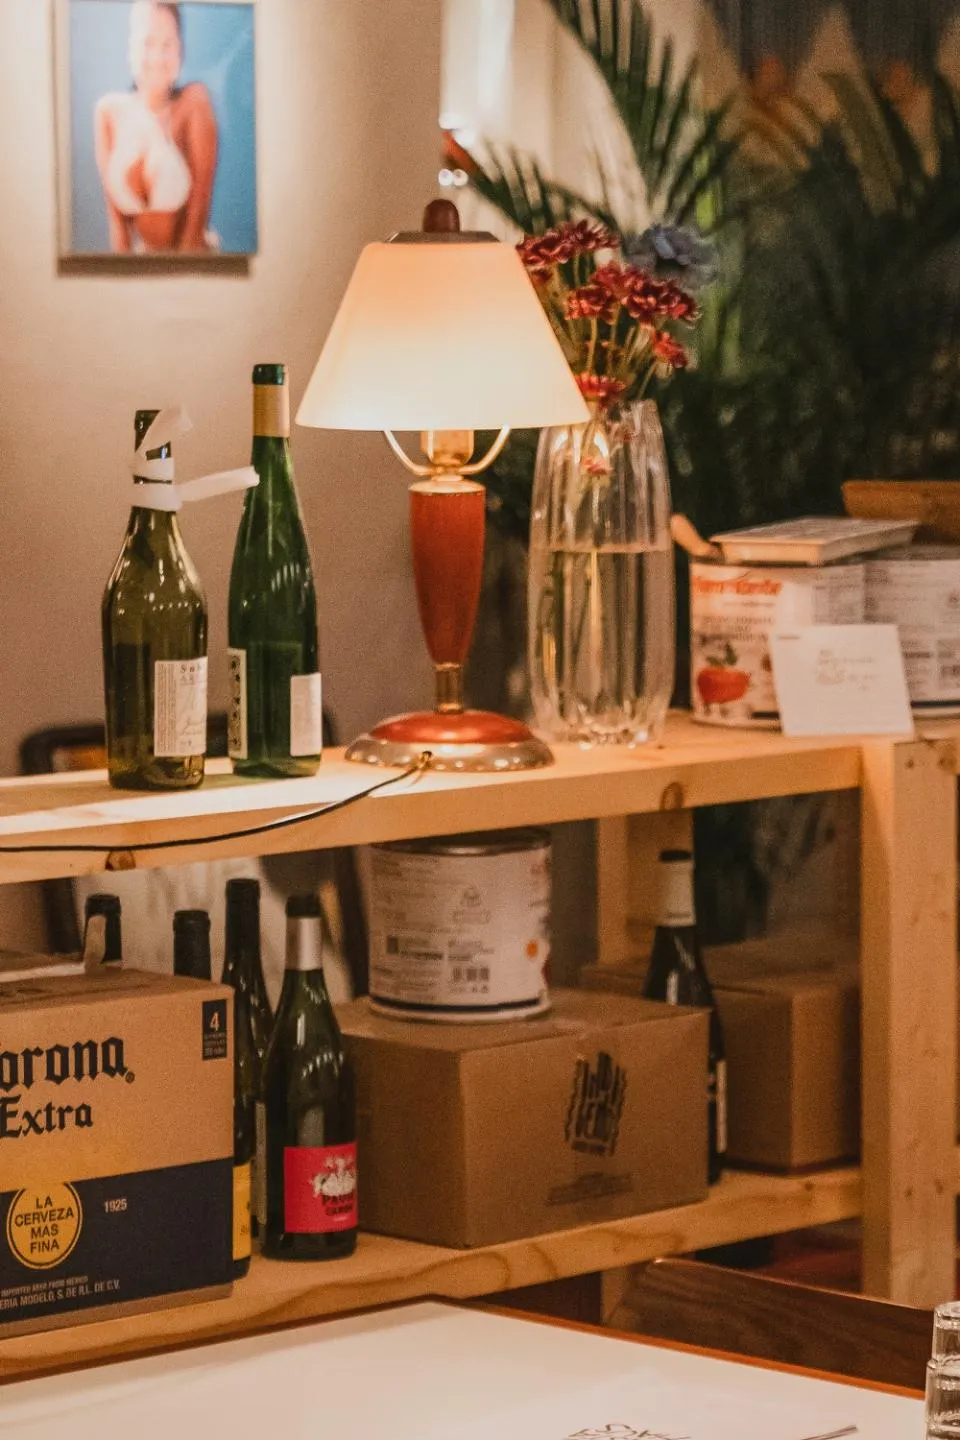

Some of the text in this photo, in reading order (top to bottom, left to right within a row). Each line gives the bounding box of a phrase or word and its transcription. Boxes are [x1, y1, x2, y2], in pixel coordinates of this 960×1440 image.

[209, 1011, 220, 1032] 4
[0, 1036, 128, 1093] orona
[0, 1094, 94, 1138] Extra
[35, 1195, 53, 1209] LA
[104, 1198, 128, 1213] 1925
[14, 1207, 75, 1228] CERVEZA
[30, 1223, 59, 1239] MAS
[30, 1240, 60, 1254] FINA
